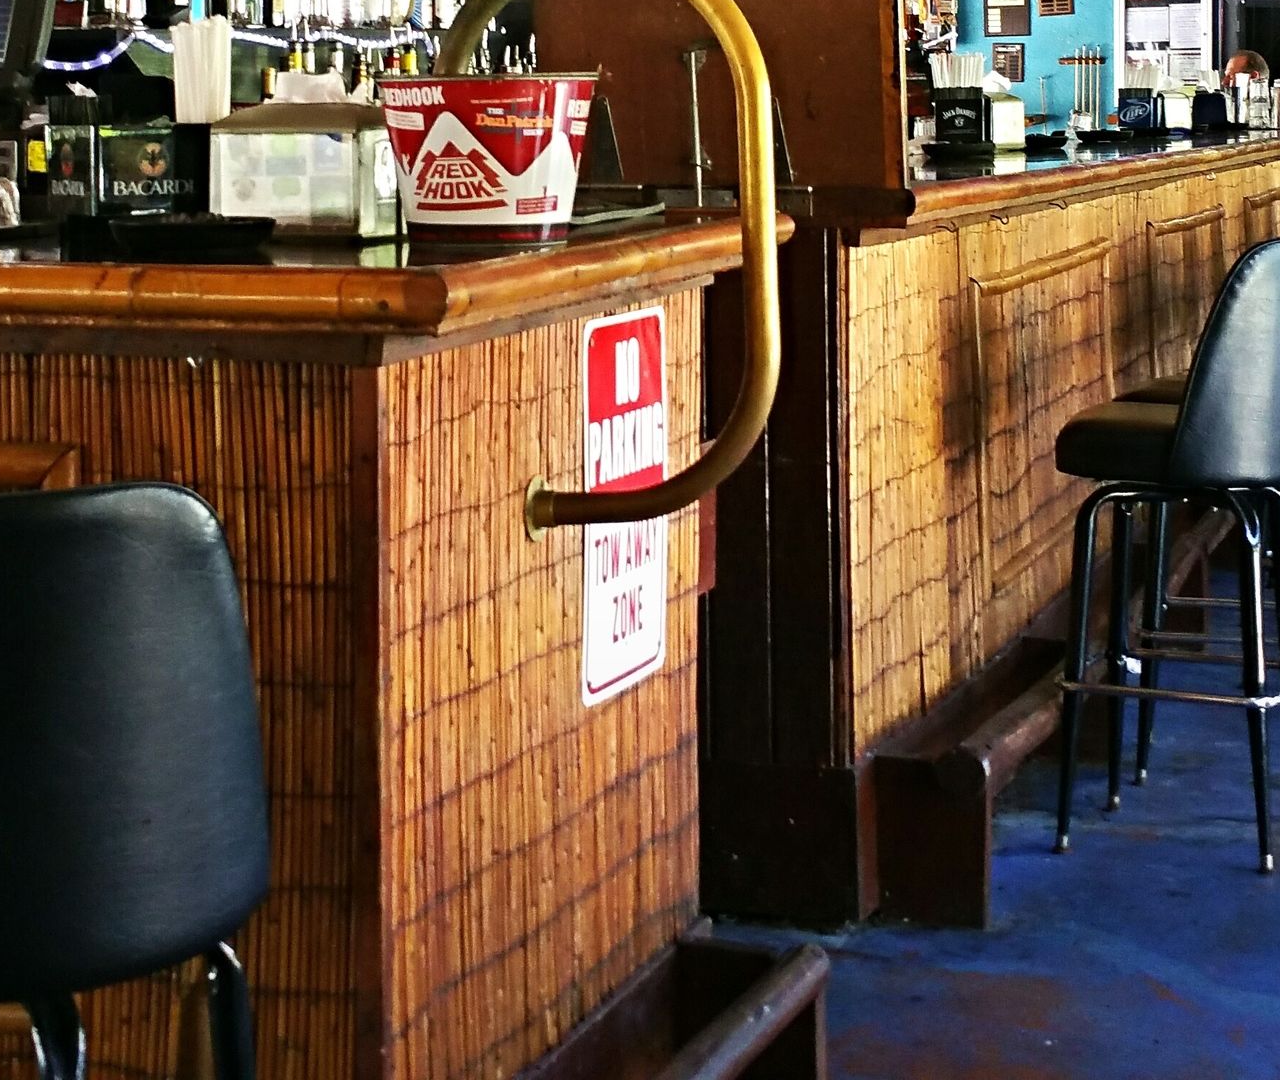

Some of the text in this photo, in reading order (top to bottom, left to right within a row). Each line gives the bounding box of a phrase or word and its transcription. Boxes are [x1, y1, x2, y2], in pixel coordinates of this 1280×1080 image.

[475, 113, 504, 127] Dan
[113, 179, 195, 196] BACARDI
[423, 180, 494, 200] HOOK
[429, 163, 479, 179] RED
[614, 336, 640, 406] NO
[589, 401, 663, 489] PARKING
[595, 518, 658, 587] TOW AWAY
[612, 585, 644, 643] ZONE
